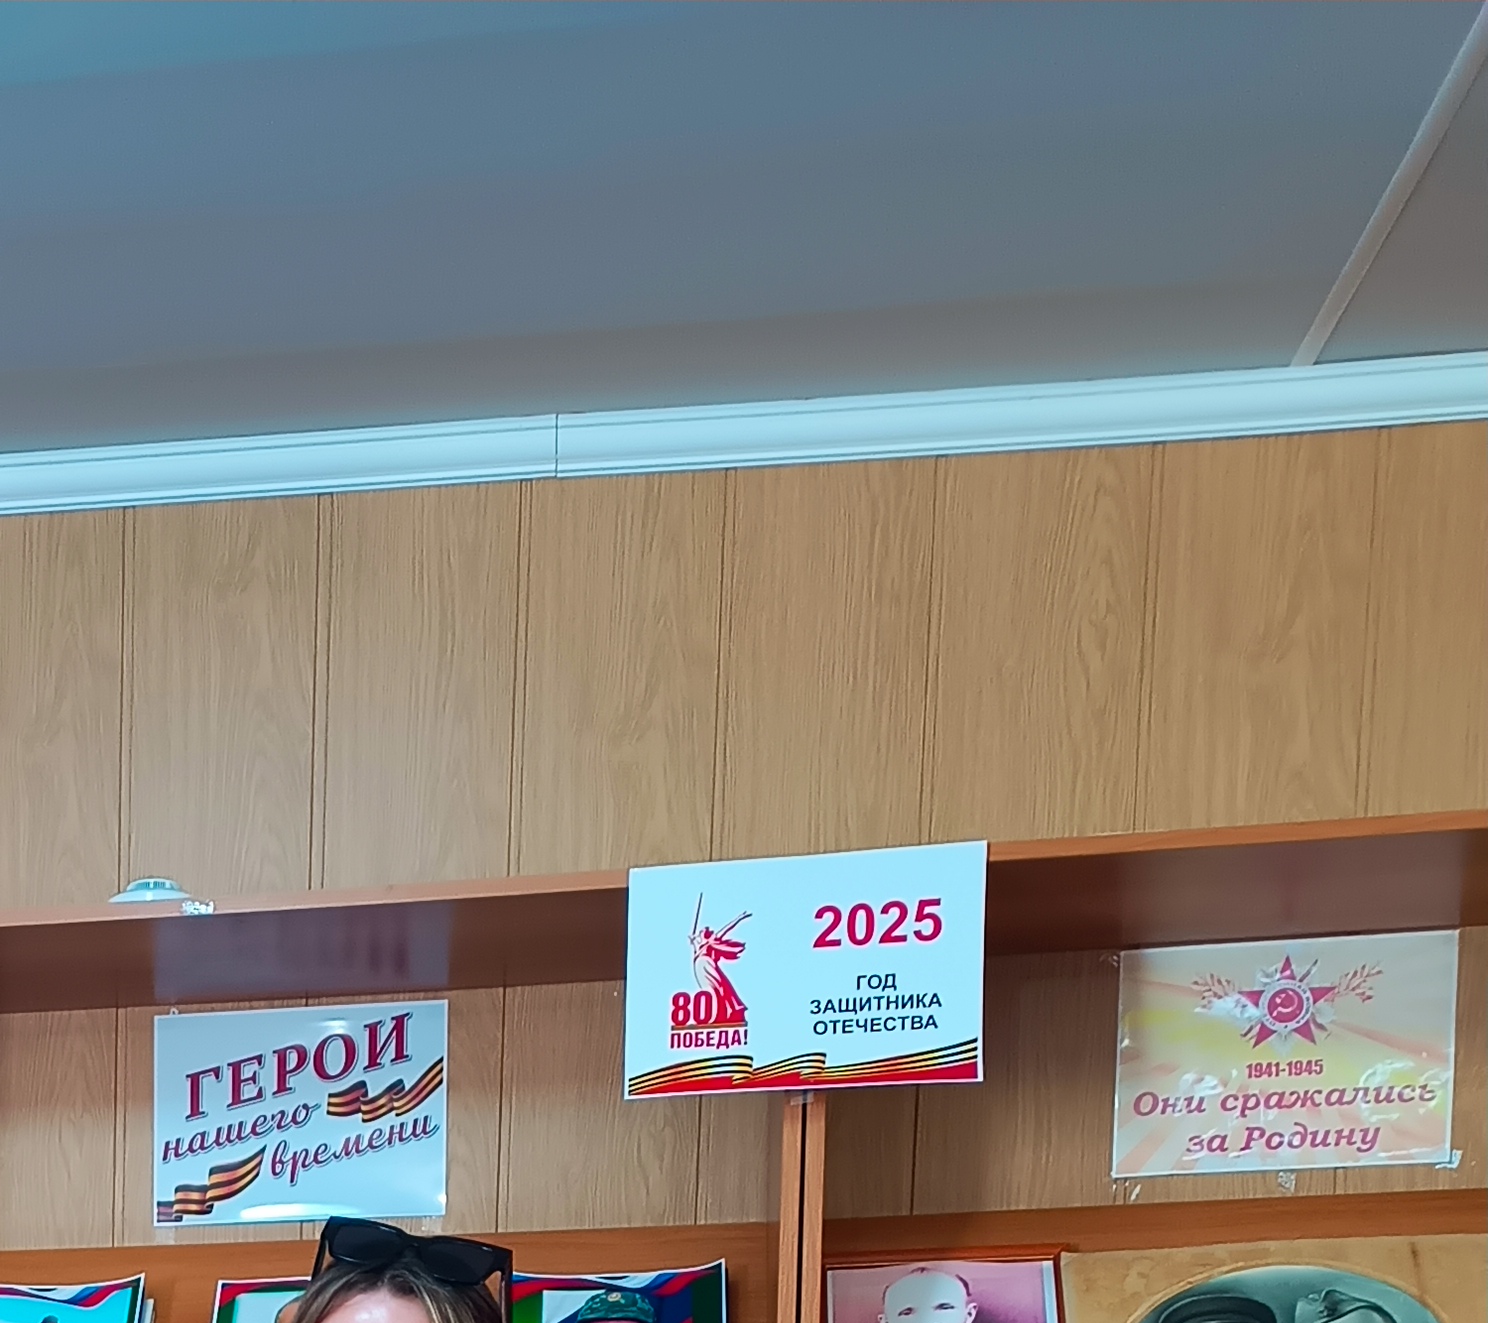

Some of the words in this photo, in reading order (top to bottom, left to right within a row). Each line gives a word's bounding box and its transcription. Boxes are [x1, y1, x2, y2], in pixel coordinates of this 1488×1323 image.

[812, 898, 943, 948] 2025
[856, 973, 897, 991] ГОД
[671, 991, 712, 1026] 80
[810, 992, 942, 1015] ЗАЩИТНИКА
[670, 1029, 748, 1049] ПОБЕДА!
[813, 1014, 938, 1035] ОТЕЧЕСТВА
[186, 1012, 412, 1121] ГЕРОИ
[1246, 1059, 1323, 1079] 1941-1945
[1133, 1090, 1206, 1117] Они
[1220, 1080, 1437, 1118] сражались
[162, 1103, 320, 1162] нашего
[1186, 1132, 1228, 1153] за
[1240, 1122, 1381, 1152] Родину
[271, 1115, 439, 1185] времени
